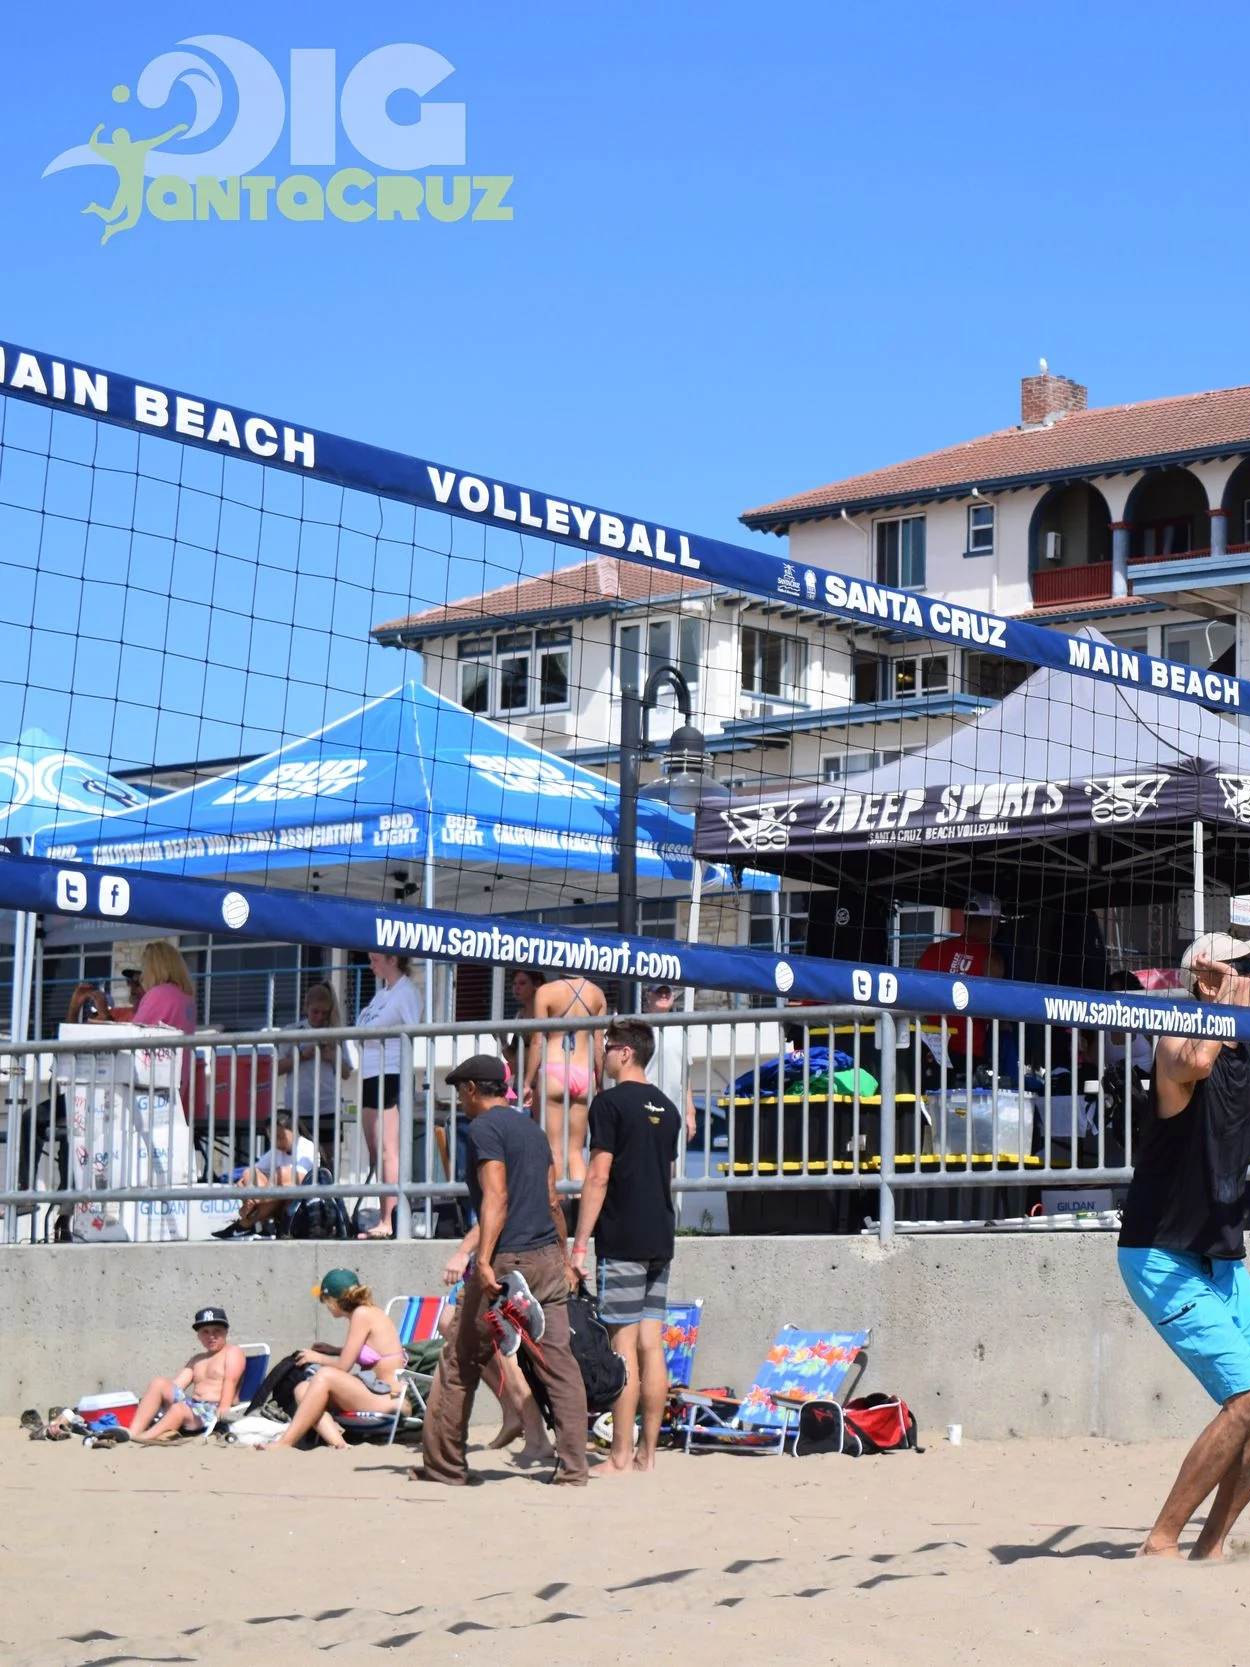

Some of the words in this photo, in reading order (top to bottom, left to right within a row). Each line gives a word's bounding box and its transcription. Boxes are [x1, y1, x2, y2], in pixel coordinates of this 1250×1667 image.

[0, 346, 108, 412] AIN
[135, 385, 316, 468] BEACH
[427, 466, 701, 570] VOLLEYBALL
[825, 575, 923, 627] SANTA
[929, 603, 1007, 649] CRUZ
[1068, 639, 1140, 682] MAIN
[1151, 660, 1240, 706] BEACH
[272, 759, 367, 782] BUD
[464, 754, 565, 780] BUD
[212, 777, 365, 804] LIGHT
[813, 788, 925, 833] 2DEEP
[936, 781, 1068, 823] SPORTS
[379, 813, 415, 830] BUD
[446, 814, 477, 831] BUD
[868, 831, 897, 845] SANTA
[898, 828, 922, 841] CRUZ
[925, 825, 955, 840] BEACH
[957, 821, 1009, 838] VOLLEYBALL
[92, 839, 163, 866] CALIFORNIA
[163, 836, 205, 860] BEACH
[207, 831, 277, 856] VOLLEYBALL
[279, 822, 363, 850] ASSOCIATION
[373, 828, 420, 847] LIGHT
[441, 827, 485, 846] LIGHT
[493, 823, 559, 848] CALIFORNIA
[561, 829, 598, 852] BEACH
[376, 917, 682, 981] www.santacruzwharf.com
[1043, 996, 1237, 1038] www.santacruzwharf.com
[140, 1200, 186, 1215] GILDAN
[200, 1199, 241, 1213] GILDA
[1057, 1201, 1095, 1211] GILDAN
